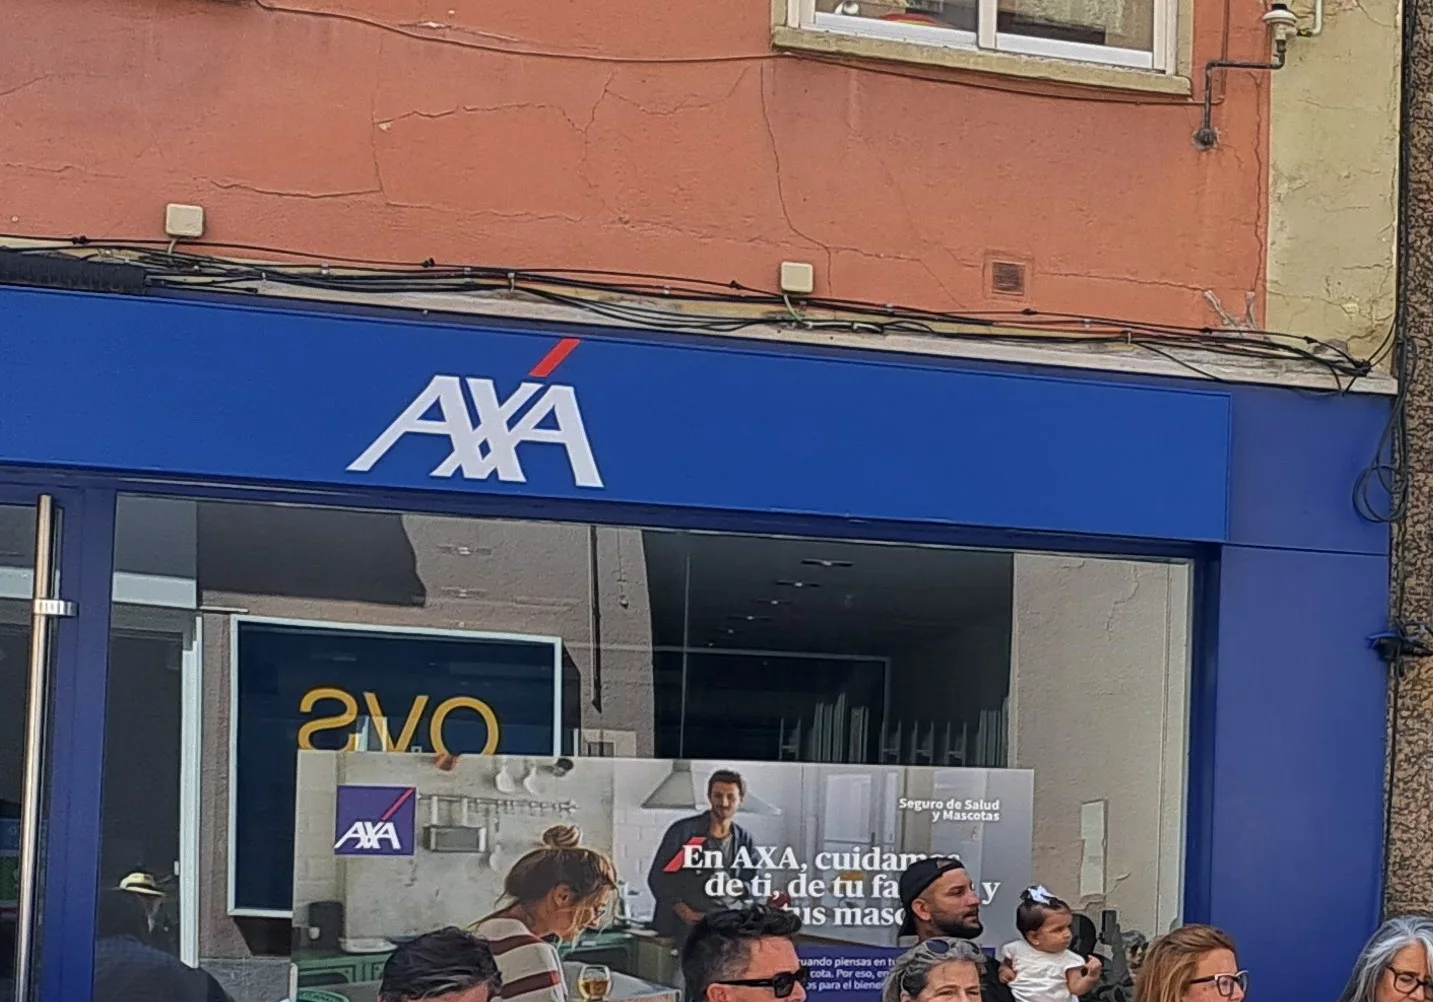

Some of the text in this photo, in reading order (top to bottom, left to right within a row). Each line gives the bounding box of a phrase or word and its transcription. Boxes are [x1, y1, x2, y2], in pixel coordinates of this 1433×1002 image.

[347, 375, 604, 488] AXA
[899, 797, 1000, 812] Seguro de Salud
[931, 810, 1000, 822] y Mascotas
[334, 821, 401, 850] AXA
[682, 845, 723, 870] En
[730, 846, 807, 873] AXA,
[705, 871, 742, 897] de
[750, 873, 781, 900] ti,
[788, 873, 826, 898] de
[832, 876, 865, 898] tu
[982, 881, 1001, 905] y
[834, 956, 872, 970] piensas
[873, 958, 885, 966] en
[836, 969, 854, 979] Por
[854, 971, 875, 980] eso,
[818, 983, 841, 993] para
[844, 980, 852, 990] el
